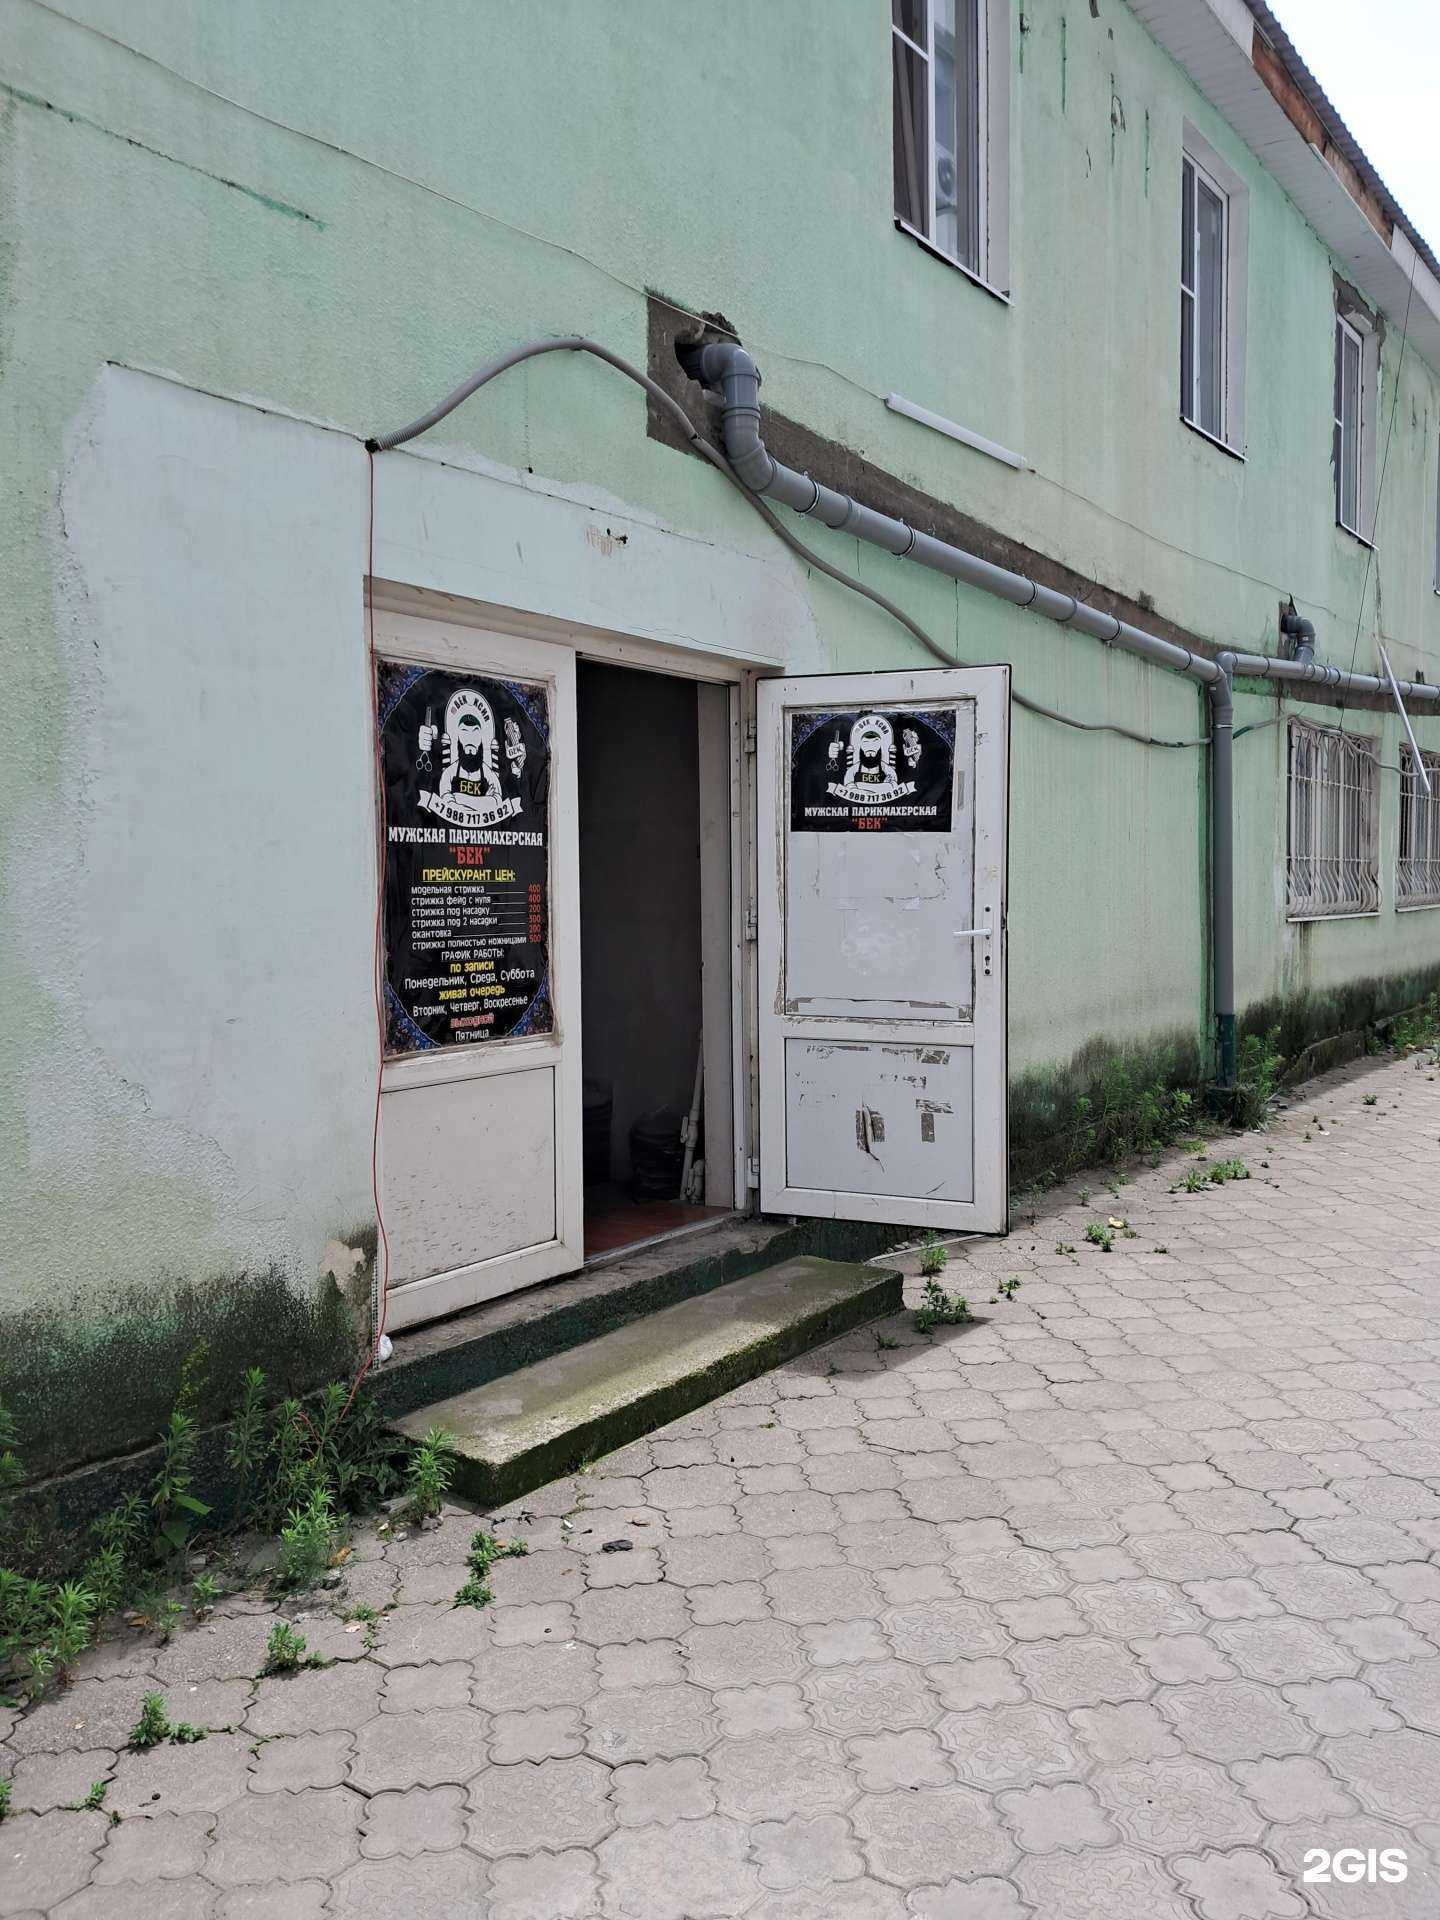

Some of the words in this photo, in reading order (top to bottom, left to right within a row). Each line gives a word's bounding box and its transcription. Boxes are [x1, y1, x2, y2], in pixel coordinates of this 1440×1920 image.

[862, 773, 880, 782] БЕК
[460, 780, 482, 796] БЕК
[839, 788, 848, 796] +7
[849, 792, 865, 802] 988
[867, 793, 879, 802] 717
[881, 792, 892, 801] 36
[893, 787, 904, 797] 92
[434, 802, 445, 814] +7
[447, 809, 464, 822] 988
[467, 813, 480, 824] 717
[483, 810, 495, 824] 36
[497, 805, 509, 820] 92
[805, 806, 848, 817] МУЖСКАЯ
[852, 806, 937, 817] ПАРИКМАХЕРСКАЯ
[389, 826, 445, 843] МУЖСКАЯ
[449, 829, 543, 846] ПАРИКМАХЕРСКАЯ
[423, 868, 490, 881] ПРЕЙСКУРАНТ
[495, 869, 515, 881] ЦЕН:
[411, 886, 452, 895] модельная
[454, 886, 484, 894] стрижка
[411, 897, 444, 906] стрижка
[447, 896, 466, 905] фейд
[411, 908, 444, 917] стрижка
[447, 908, 460, 916] под
[463, 907, 490, 915] насадку
[412, 919, 445, 928] стрижка
[447, 918, 461, 927] под
[469, 917, 498, 926] насадки
[412, 930, 452, 938] окантовка
[412, 940, 445, 950] стрижка
[448, 939, 486, 948] полностью
[489, 936, 527, 945] ножницами
[441, 951, 470, 960] ГРАФИК
[474, 949, 504, 958] РАБОТЫ:
[450, 963, 461, 973] по
[464, 961, 495, 972] записи
[405, 976, 467, 990] Понедельник,
[470, 972, 497, 984] Среда,
[501, 969, 535, 981] Суббота
[438, 988, 467, 1001] живая
[470, 985, 505, 997] очередь
[413, 1005, 447, 1017] Вторник,
[450, 1001, 481, 1012] Четверг,
[484, 996, 528, 1009] Воскресенье
[455, 1029, 490, 1042] Пятница
